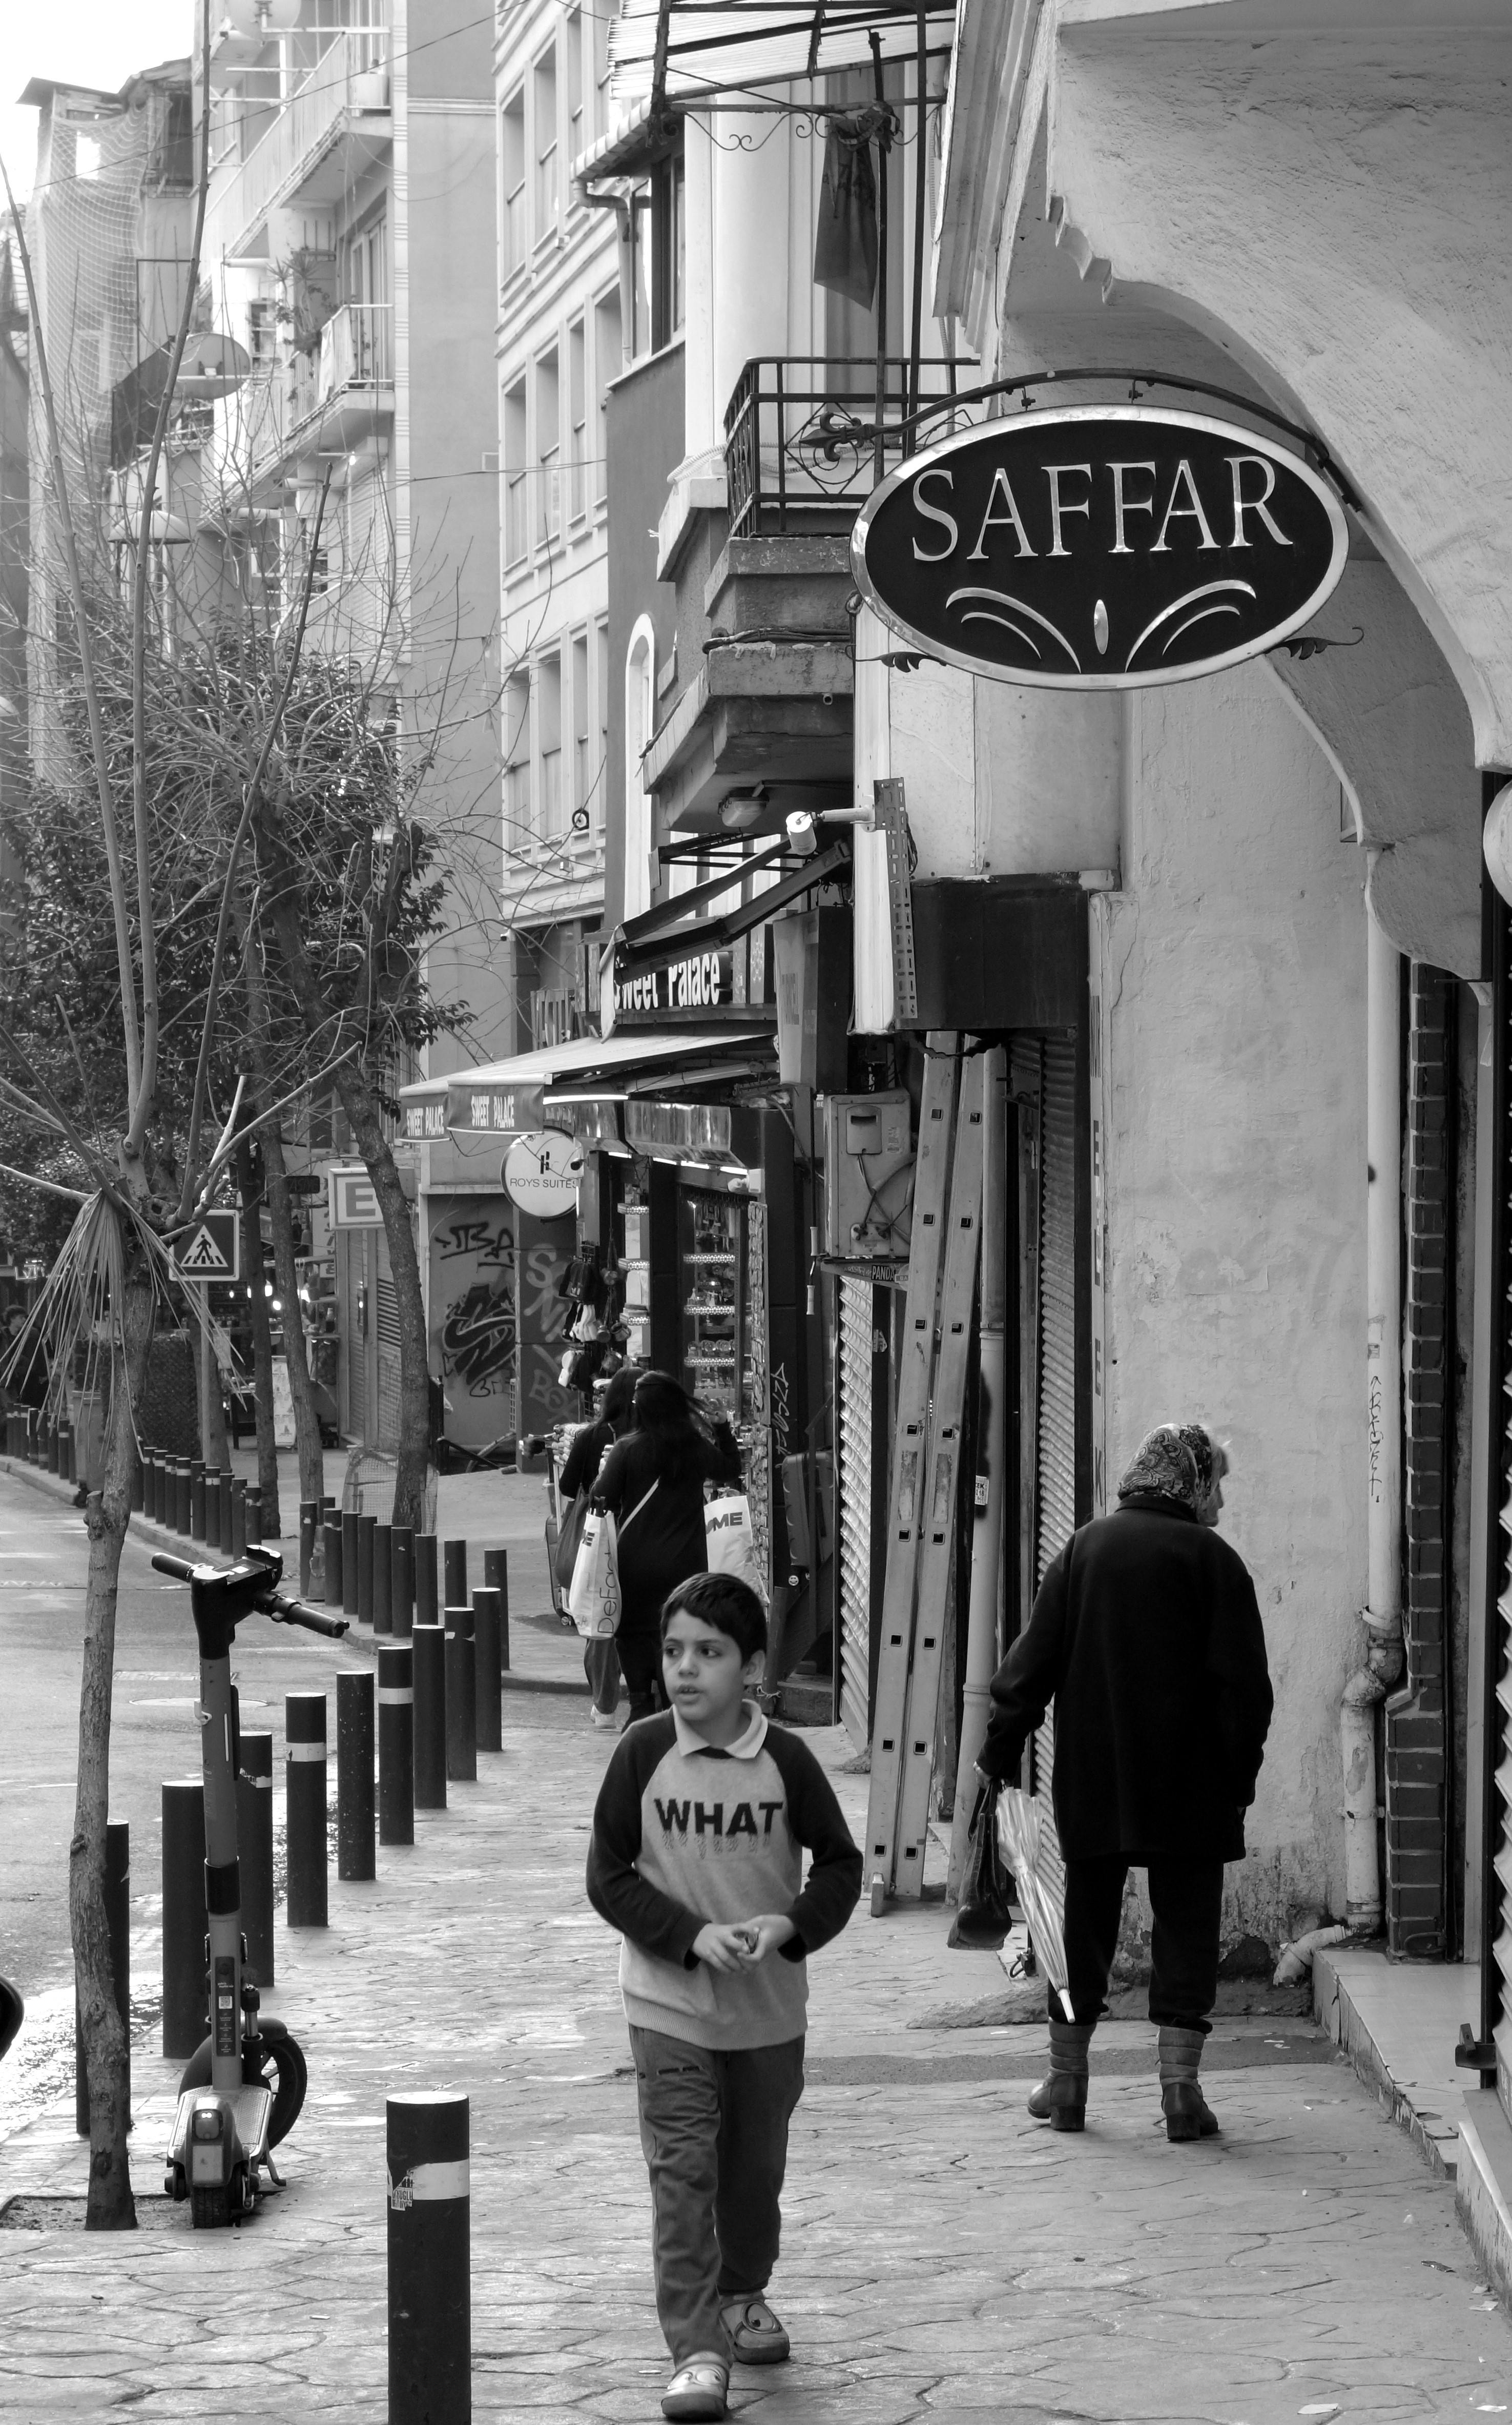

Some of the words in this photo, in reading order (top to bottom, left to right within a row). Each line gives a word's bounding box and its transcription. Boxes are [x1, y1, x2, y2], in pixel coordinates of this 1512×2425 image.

[912, 456, 1294, 562] SAFFAR
[668, 952, 720, 1007] Palace
[406, 1107, 423, 1137] SWEET
[425, 1105, 444, 1136] PALACE
[471, 1095, 489, 1127] SWEET
[493, 1095, 514, 1128] PALACE
[510, 1178, 540, 1187] ROYS
[345, 1182, 376, 1218] E
[872, 1265, 895, 1281] PANDA
[654, 1798, 783, 1837] WHAT
